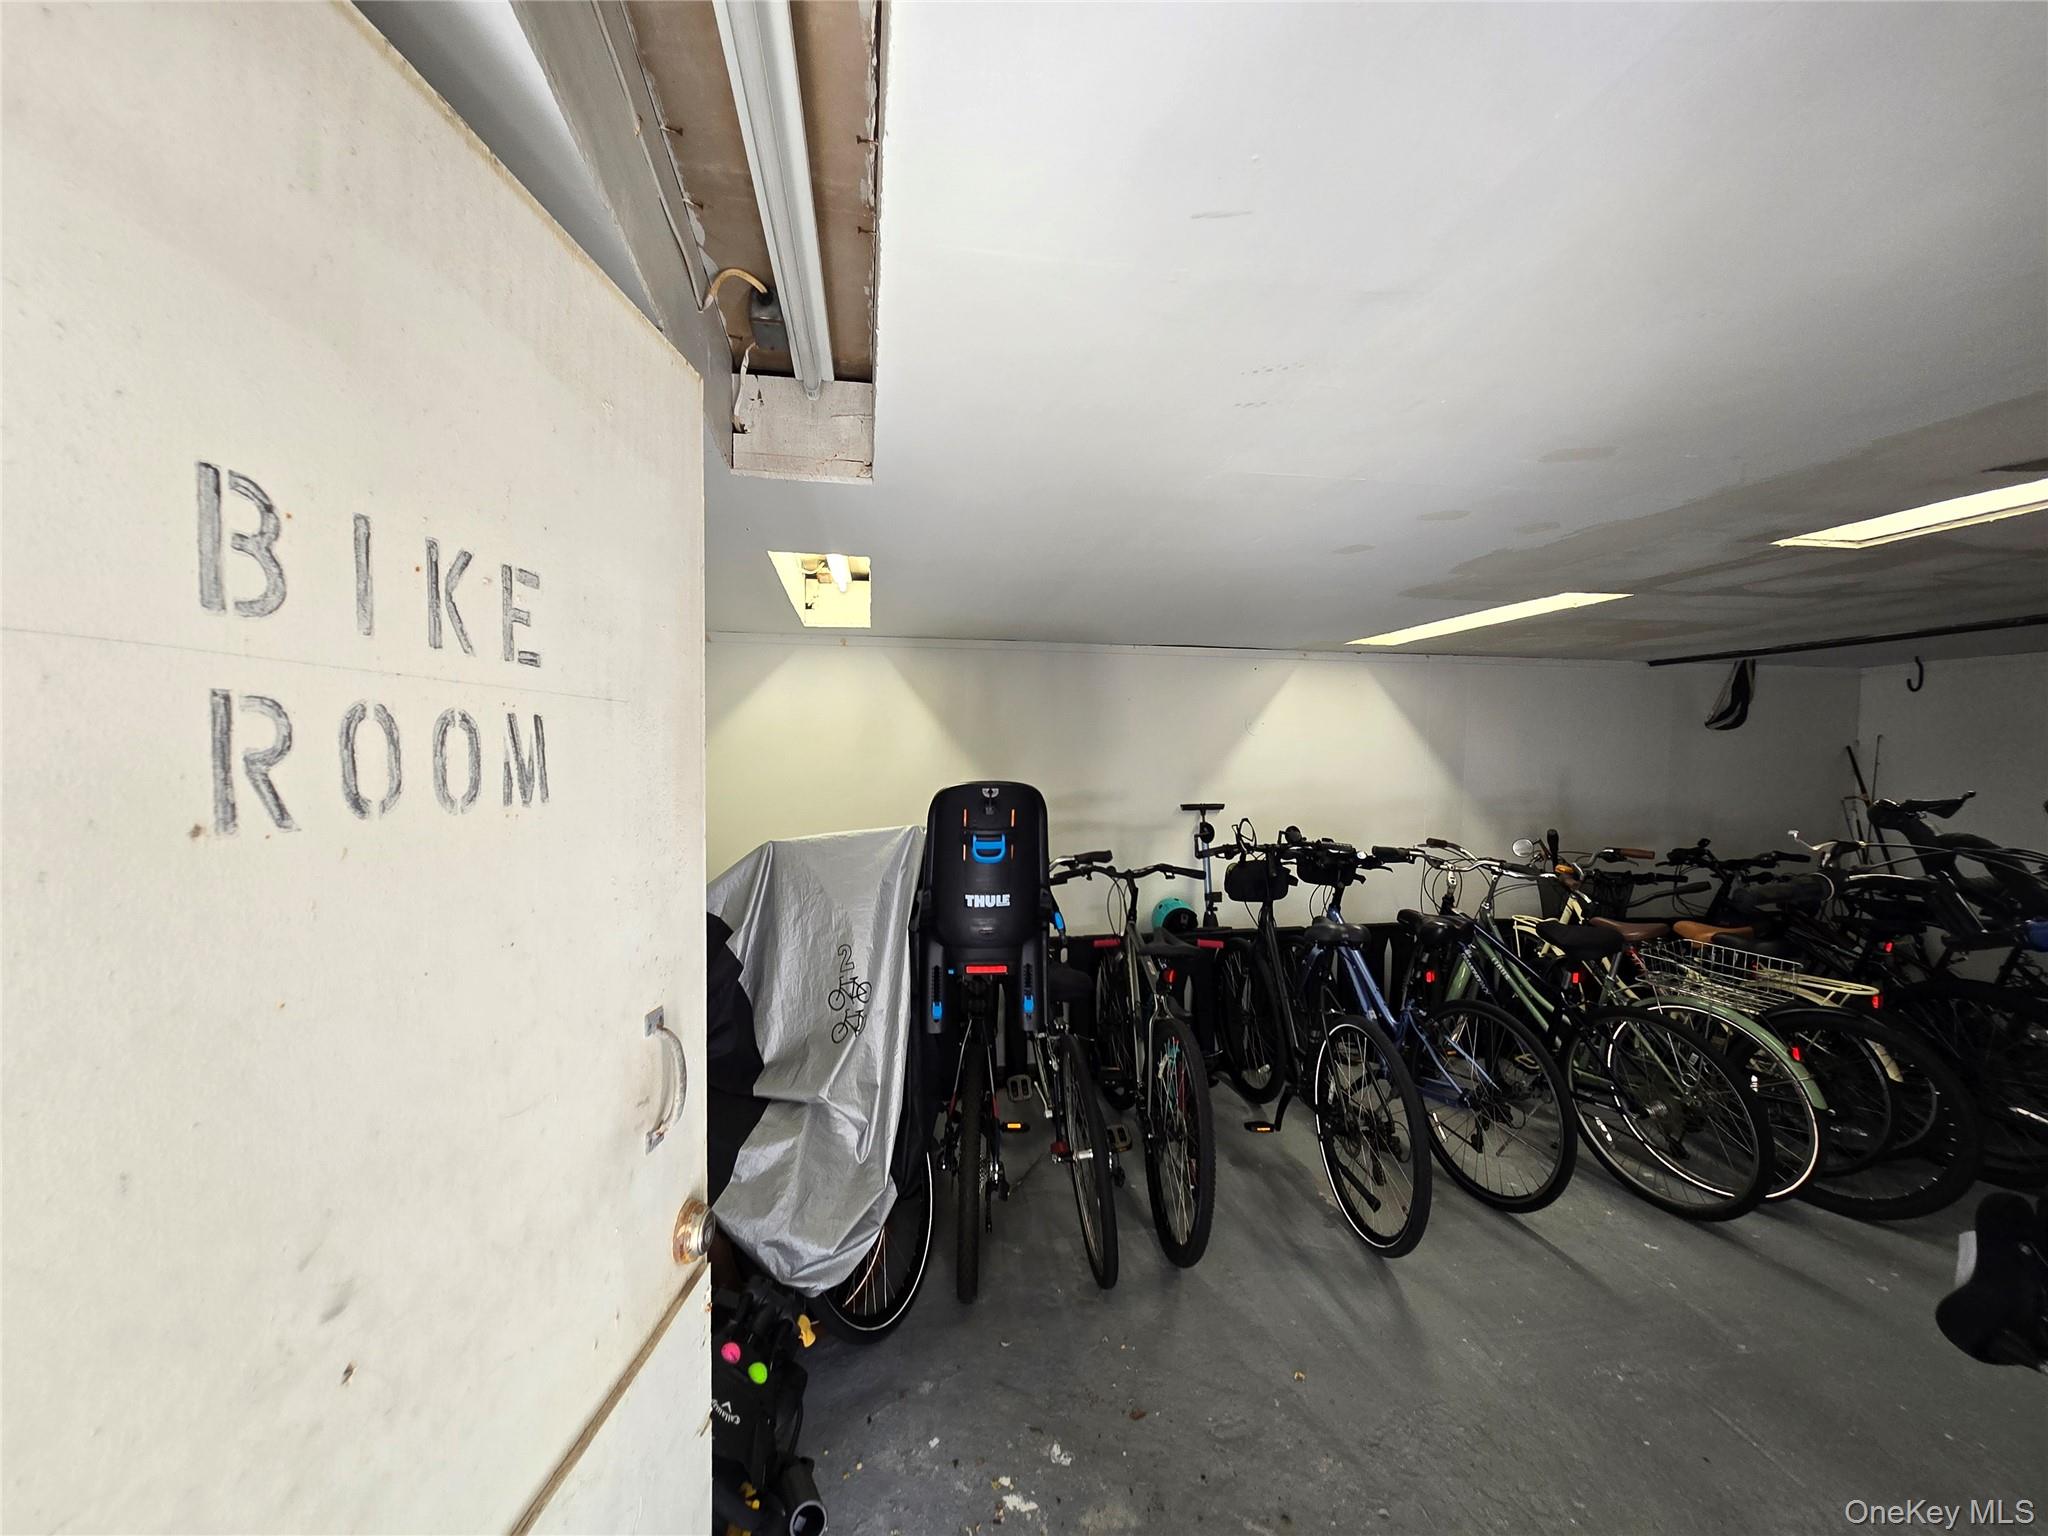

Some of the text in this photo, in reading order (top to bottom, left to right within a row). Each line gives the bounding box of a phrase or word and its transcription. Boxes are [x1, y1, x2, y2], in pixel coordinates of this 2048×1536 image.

[197, 461, 541, 667] BIKE
[210, 689, 549, 835] ROOM
[964, 893, 1011, 908] THULE
[837, 943, 855, 973] 2
